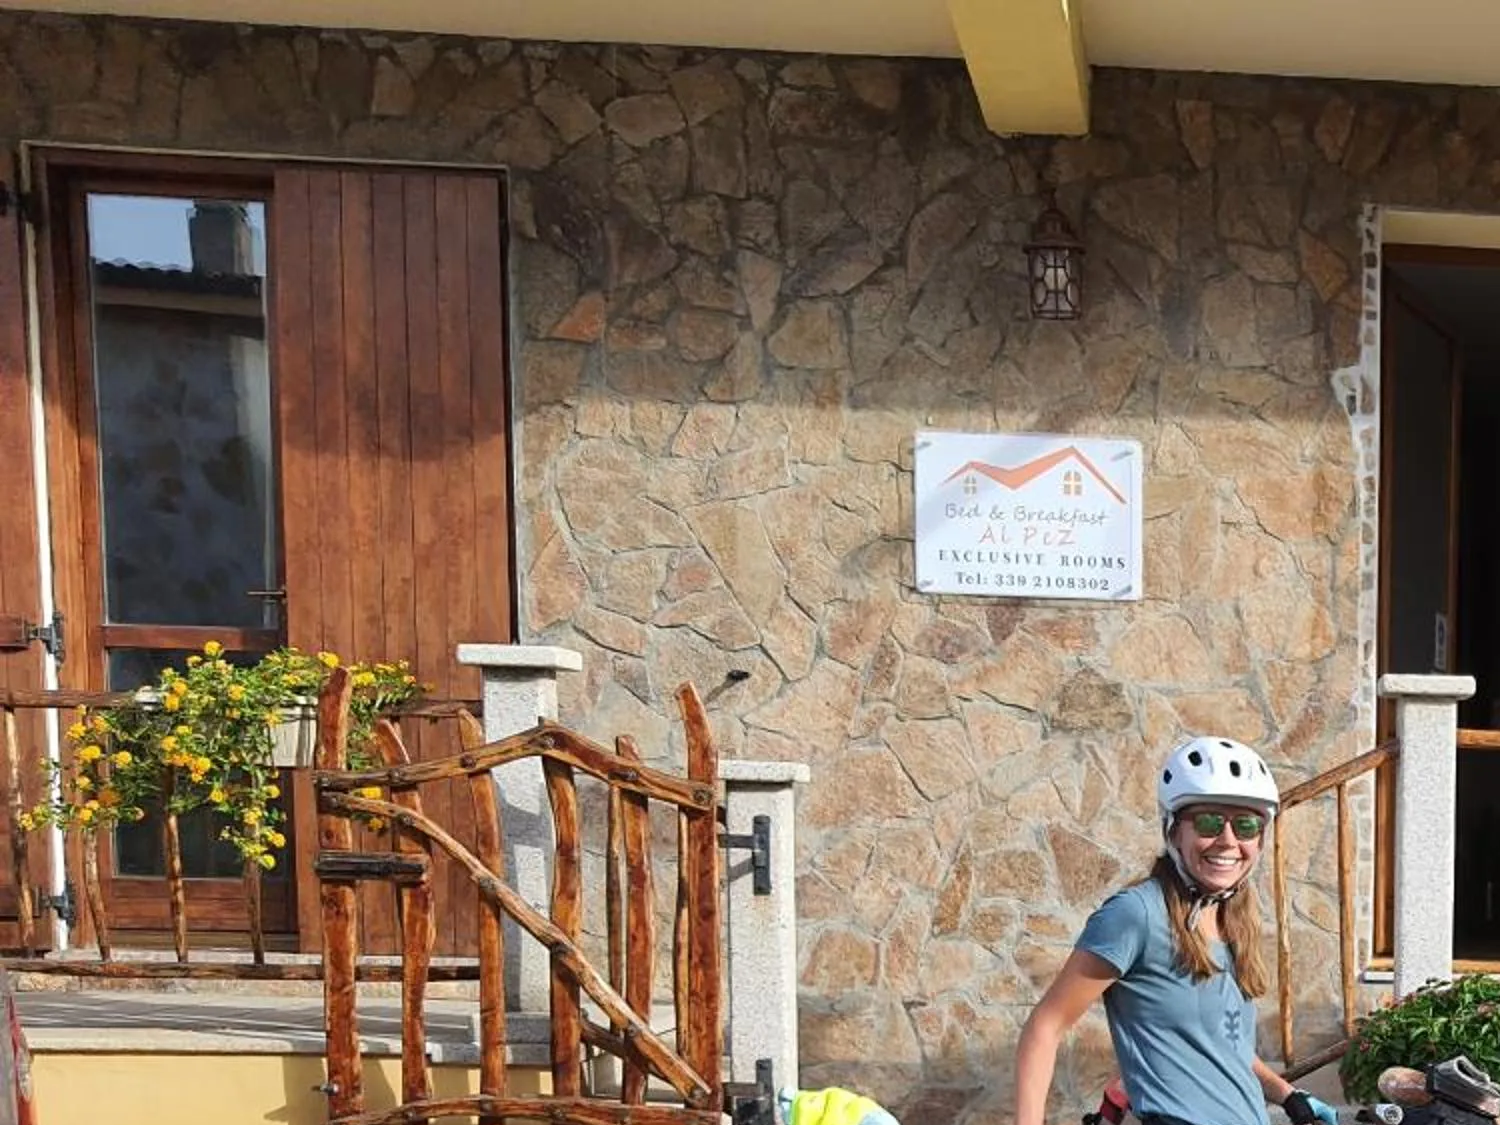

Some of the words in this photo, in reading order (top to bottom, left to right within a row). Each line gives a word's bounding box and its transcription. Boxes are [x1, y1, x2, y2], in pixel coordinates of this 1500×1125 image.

[945, 503, 981, 518] Bed
[989, 505, 1005, 520] &
[1013, 505, 1108, 526] Breakfast
[938, 549, 1047, 566] EXCLUSIVE
[1058, 554, 1126, 569] ROOMS
[956, 571, 988, 586] Tel:
